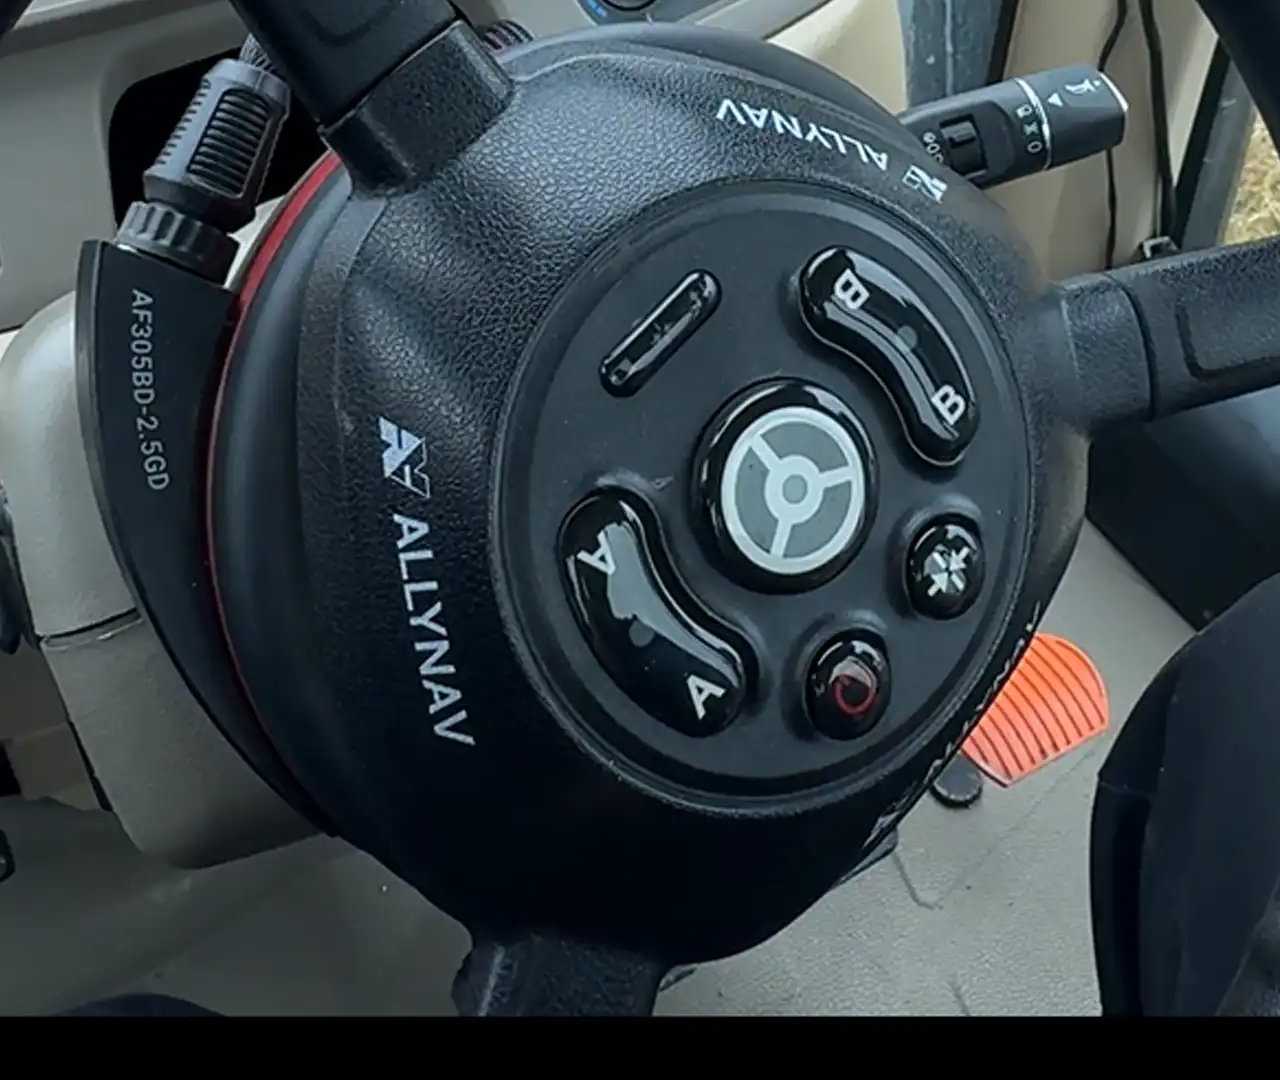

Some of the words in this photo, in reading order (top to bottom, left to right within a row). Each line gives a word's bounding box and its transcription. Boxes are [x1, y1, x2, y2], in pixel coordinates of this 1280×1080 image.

[715, 98, 889, 172] ALLYNAV
[131, 287, 170, 492] AF305BD-2.5GD
[929, 384, 967, 423] B
[392, 512, 476, 746] ALLYNAV
[686, 673, 726, 720] A
